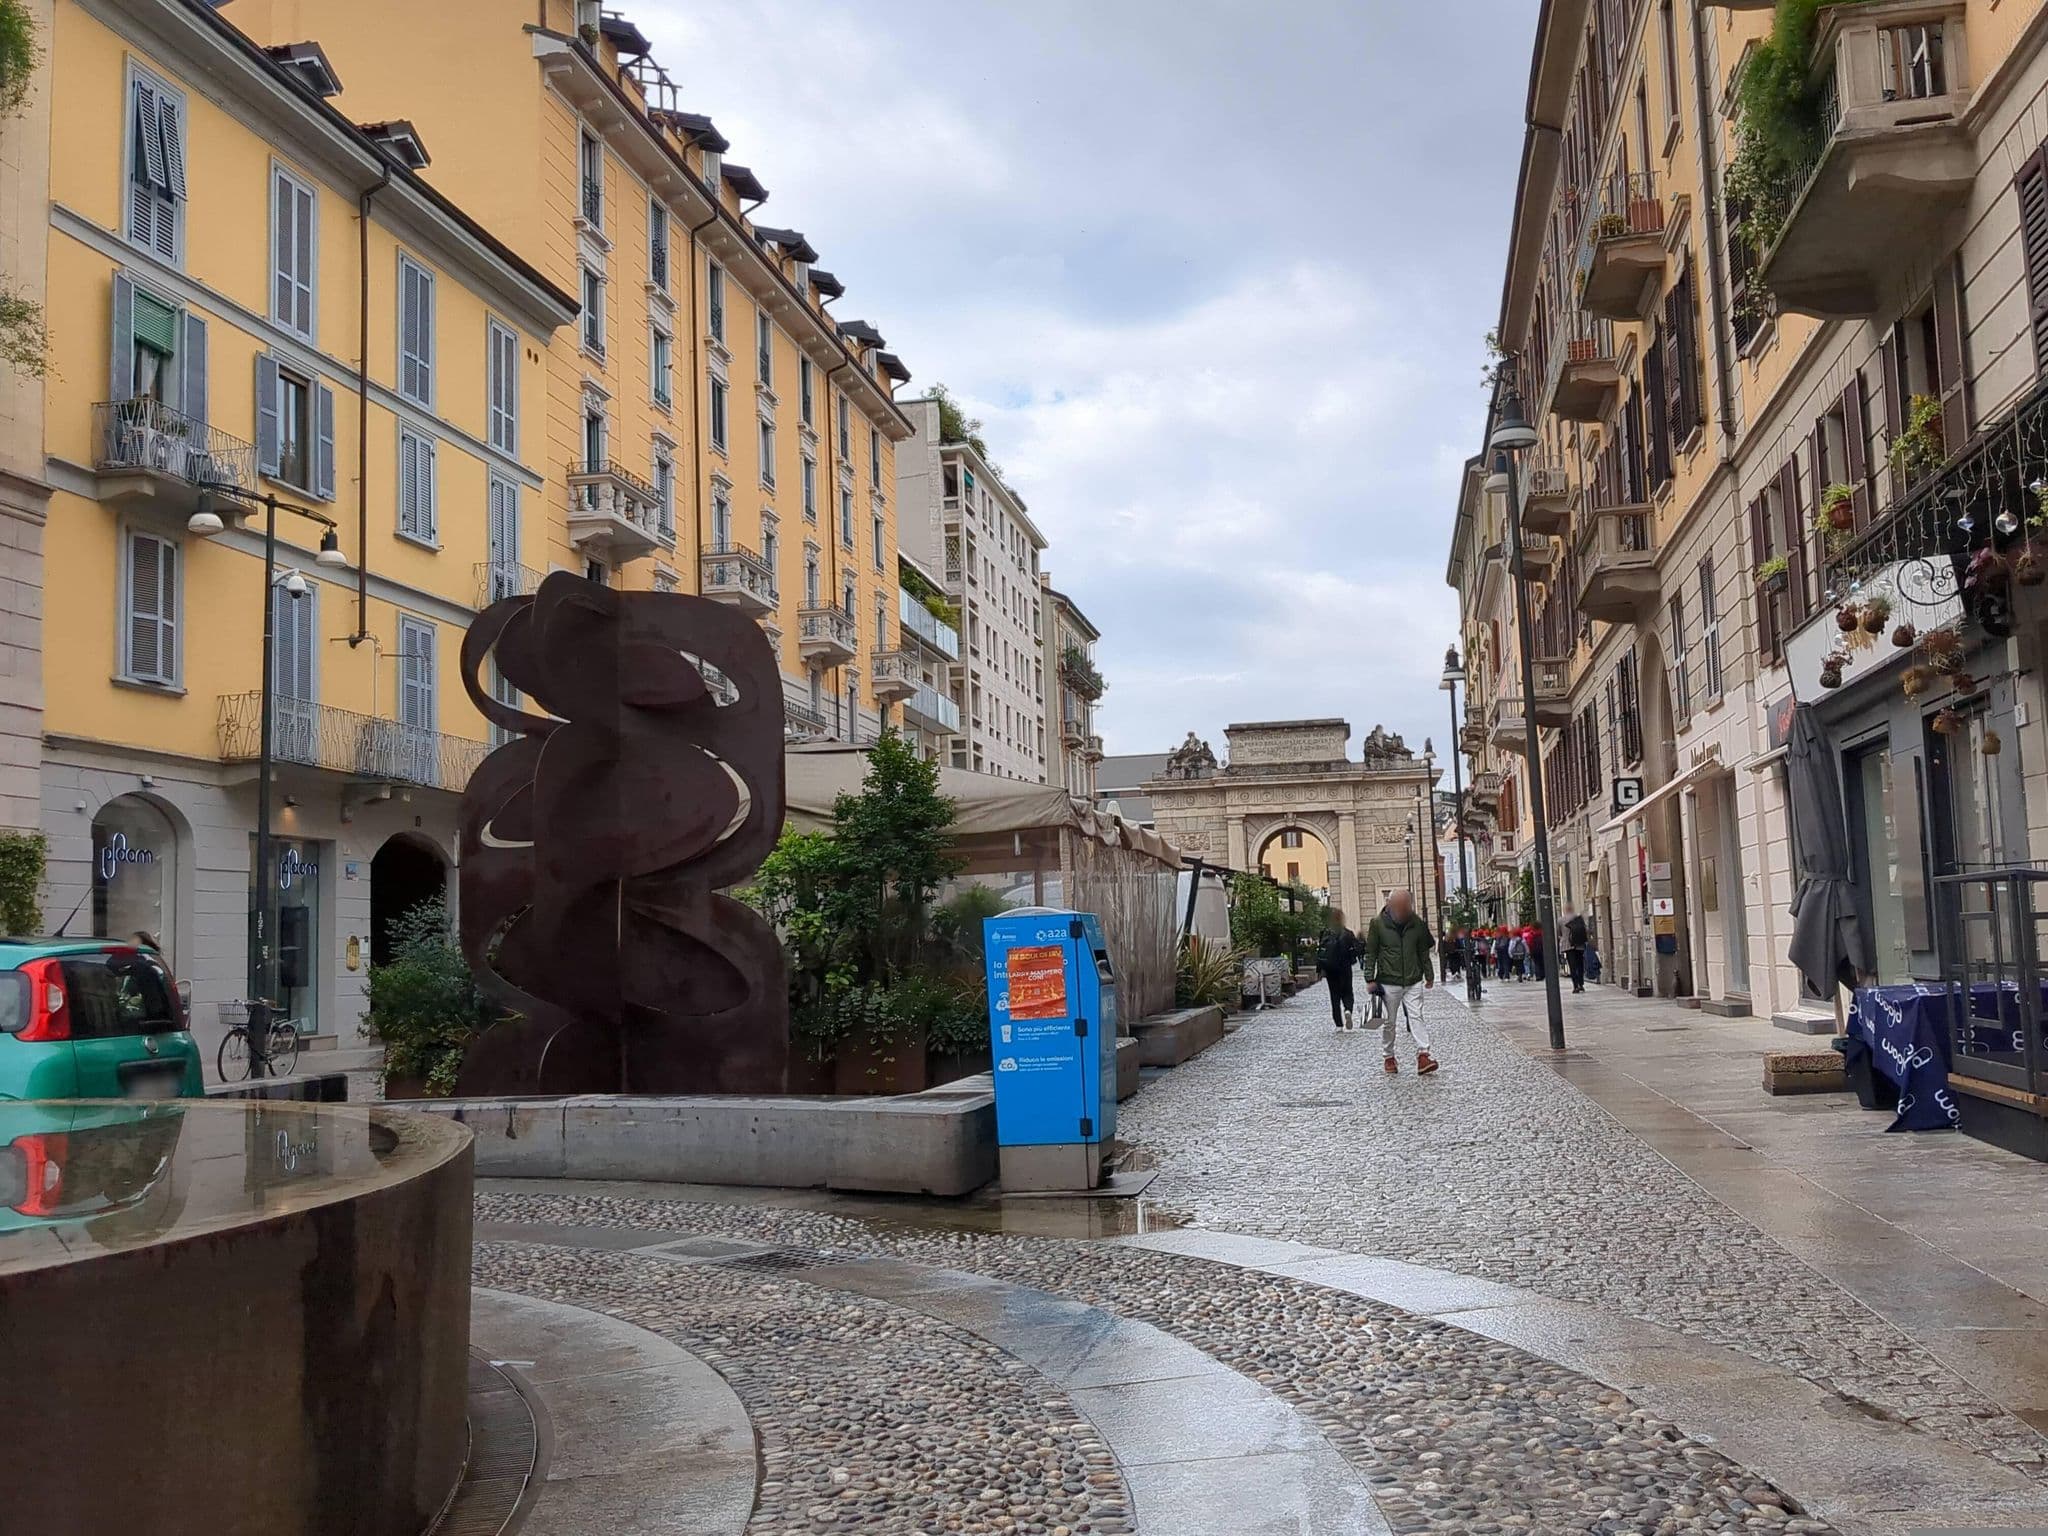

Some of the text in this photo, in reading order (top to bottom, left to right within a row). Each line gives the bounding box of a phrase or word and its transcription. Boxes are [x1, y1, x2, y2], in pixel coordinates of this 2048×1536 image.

[1617, 780, 1640, 805] G
[102, 832, 153, 880] ploom
[279, 848, 319, 889] ploom
[1047, 928, 1067, 938] a2a
